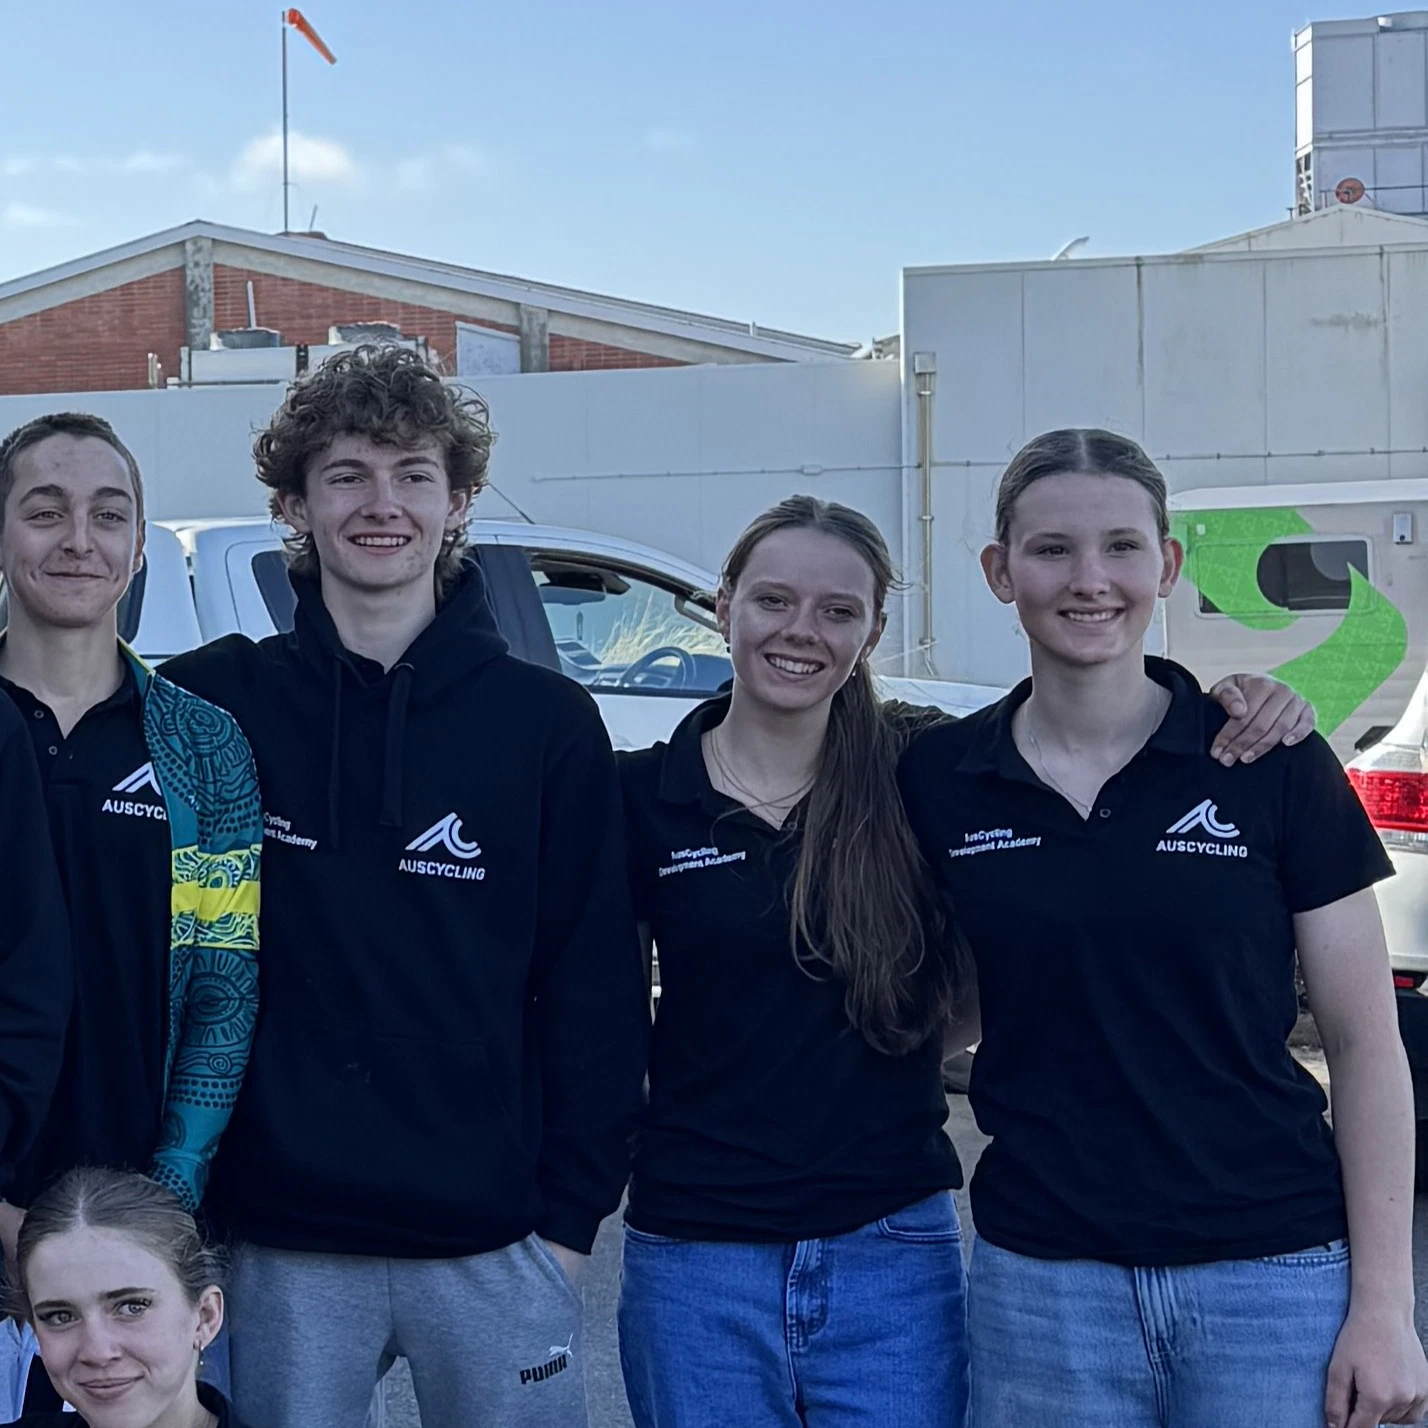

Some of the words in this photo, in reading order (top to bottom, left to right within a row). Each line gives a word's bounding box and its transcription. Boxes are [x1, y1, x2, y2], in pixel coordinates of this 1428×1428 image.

[1155, 839, 1248, 858] AUSCYCLING
[398, 858, 486, 881] AUSCYCLING
[519, 1354, 567, 1385] PUMA
